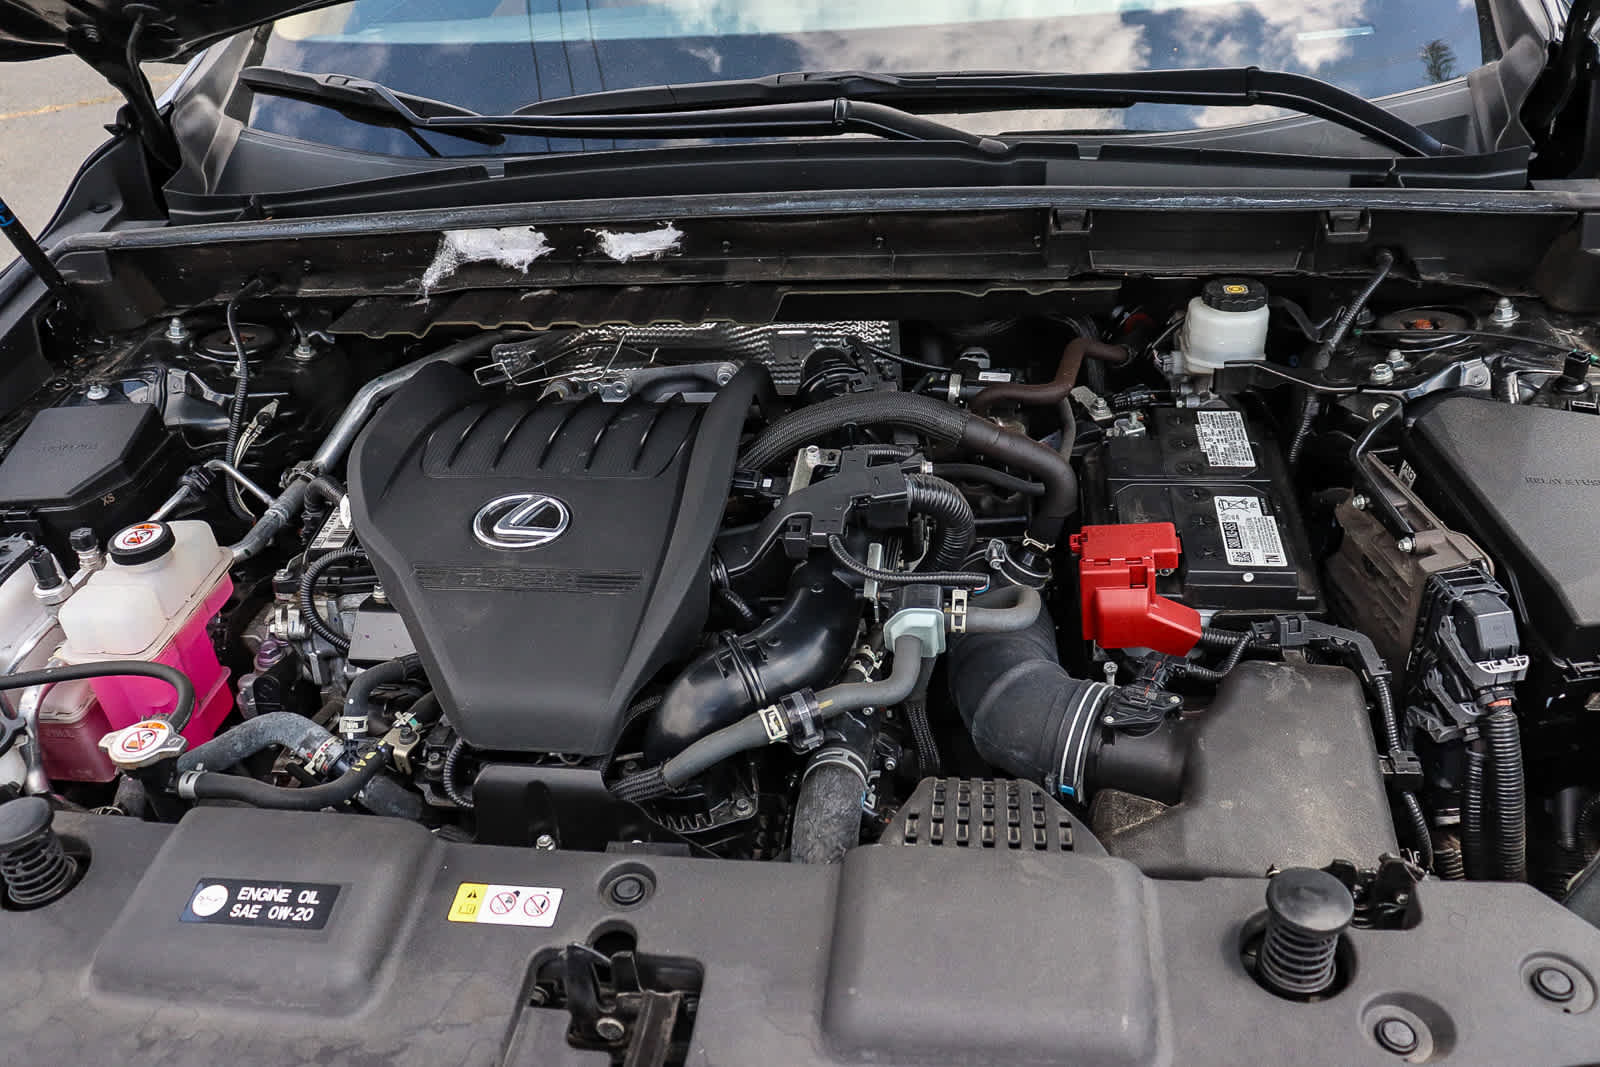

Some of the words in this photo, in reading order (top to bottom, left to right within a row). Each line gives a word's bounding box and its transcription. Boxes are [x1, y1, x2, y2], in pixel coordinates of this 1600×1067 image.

[237, 887, 292, 903] ENGINE
[297, 890, 320, 905] OIL
[229, 903, 262, 919] SAE
[267, 906, 314, 922] 0W-20
